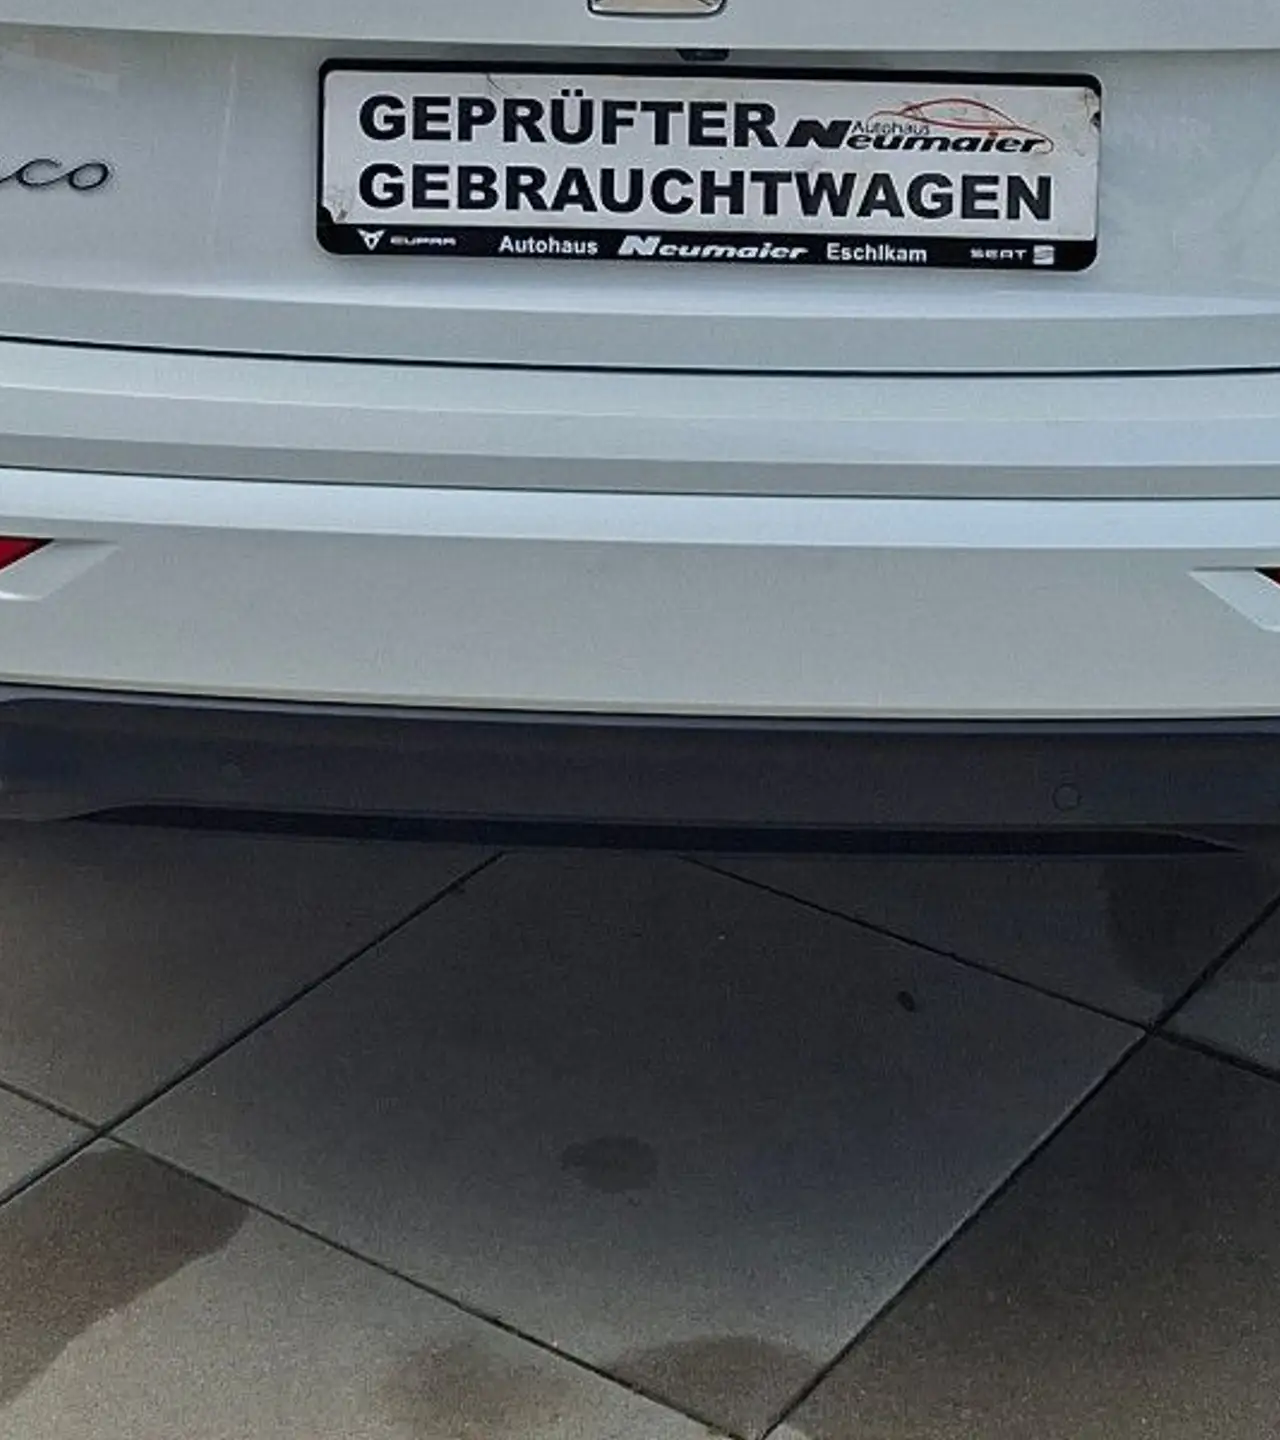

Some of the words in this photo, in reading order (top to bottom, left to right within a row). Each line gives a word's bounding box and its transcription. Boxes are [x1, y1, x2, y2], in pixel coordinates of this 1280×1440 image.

[359, 88, 778, 149] GEPRÜFTER
[851, 120, 930, 136] Autohaus
[784, 120, 1046, 153] Neumaier
[359, 163, 1052, 220] GEBRAUCHTWAGEN
[498, 234, 599, 256] Autohaus
[618, 234, 810, 260] Neumaier
[827, 243, 928, 263] Eschlkam
[970, 249, 1027, 261] SEAT
